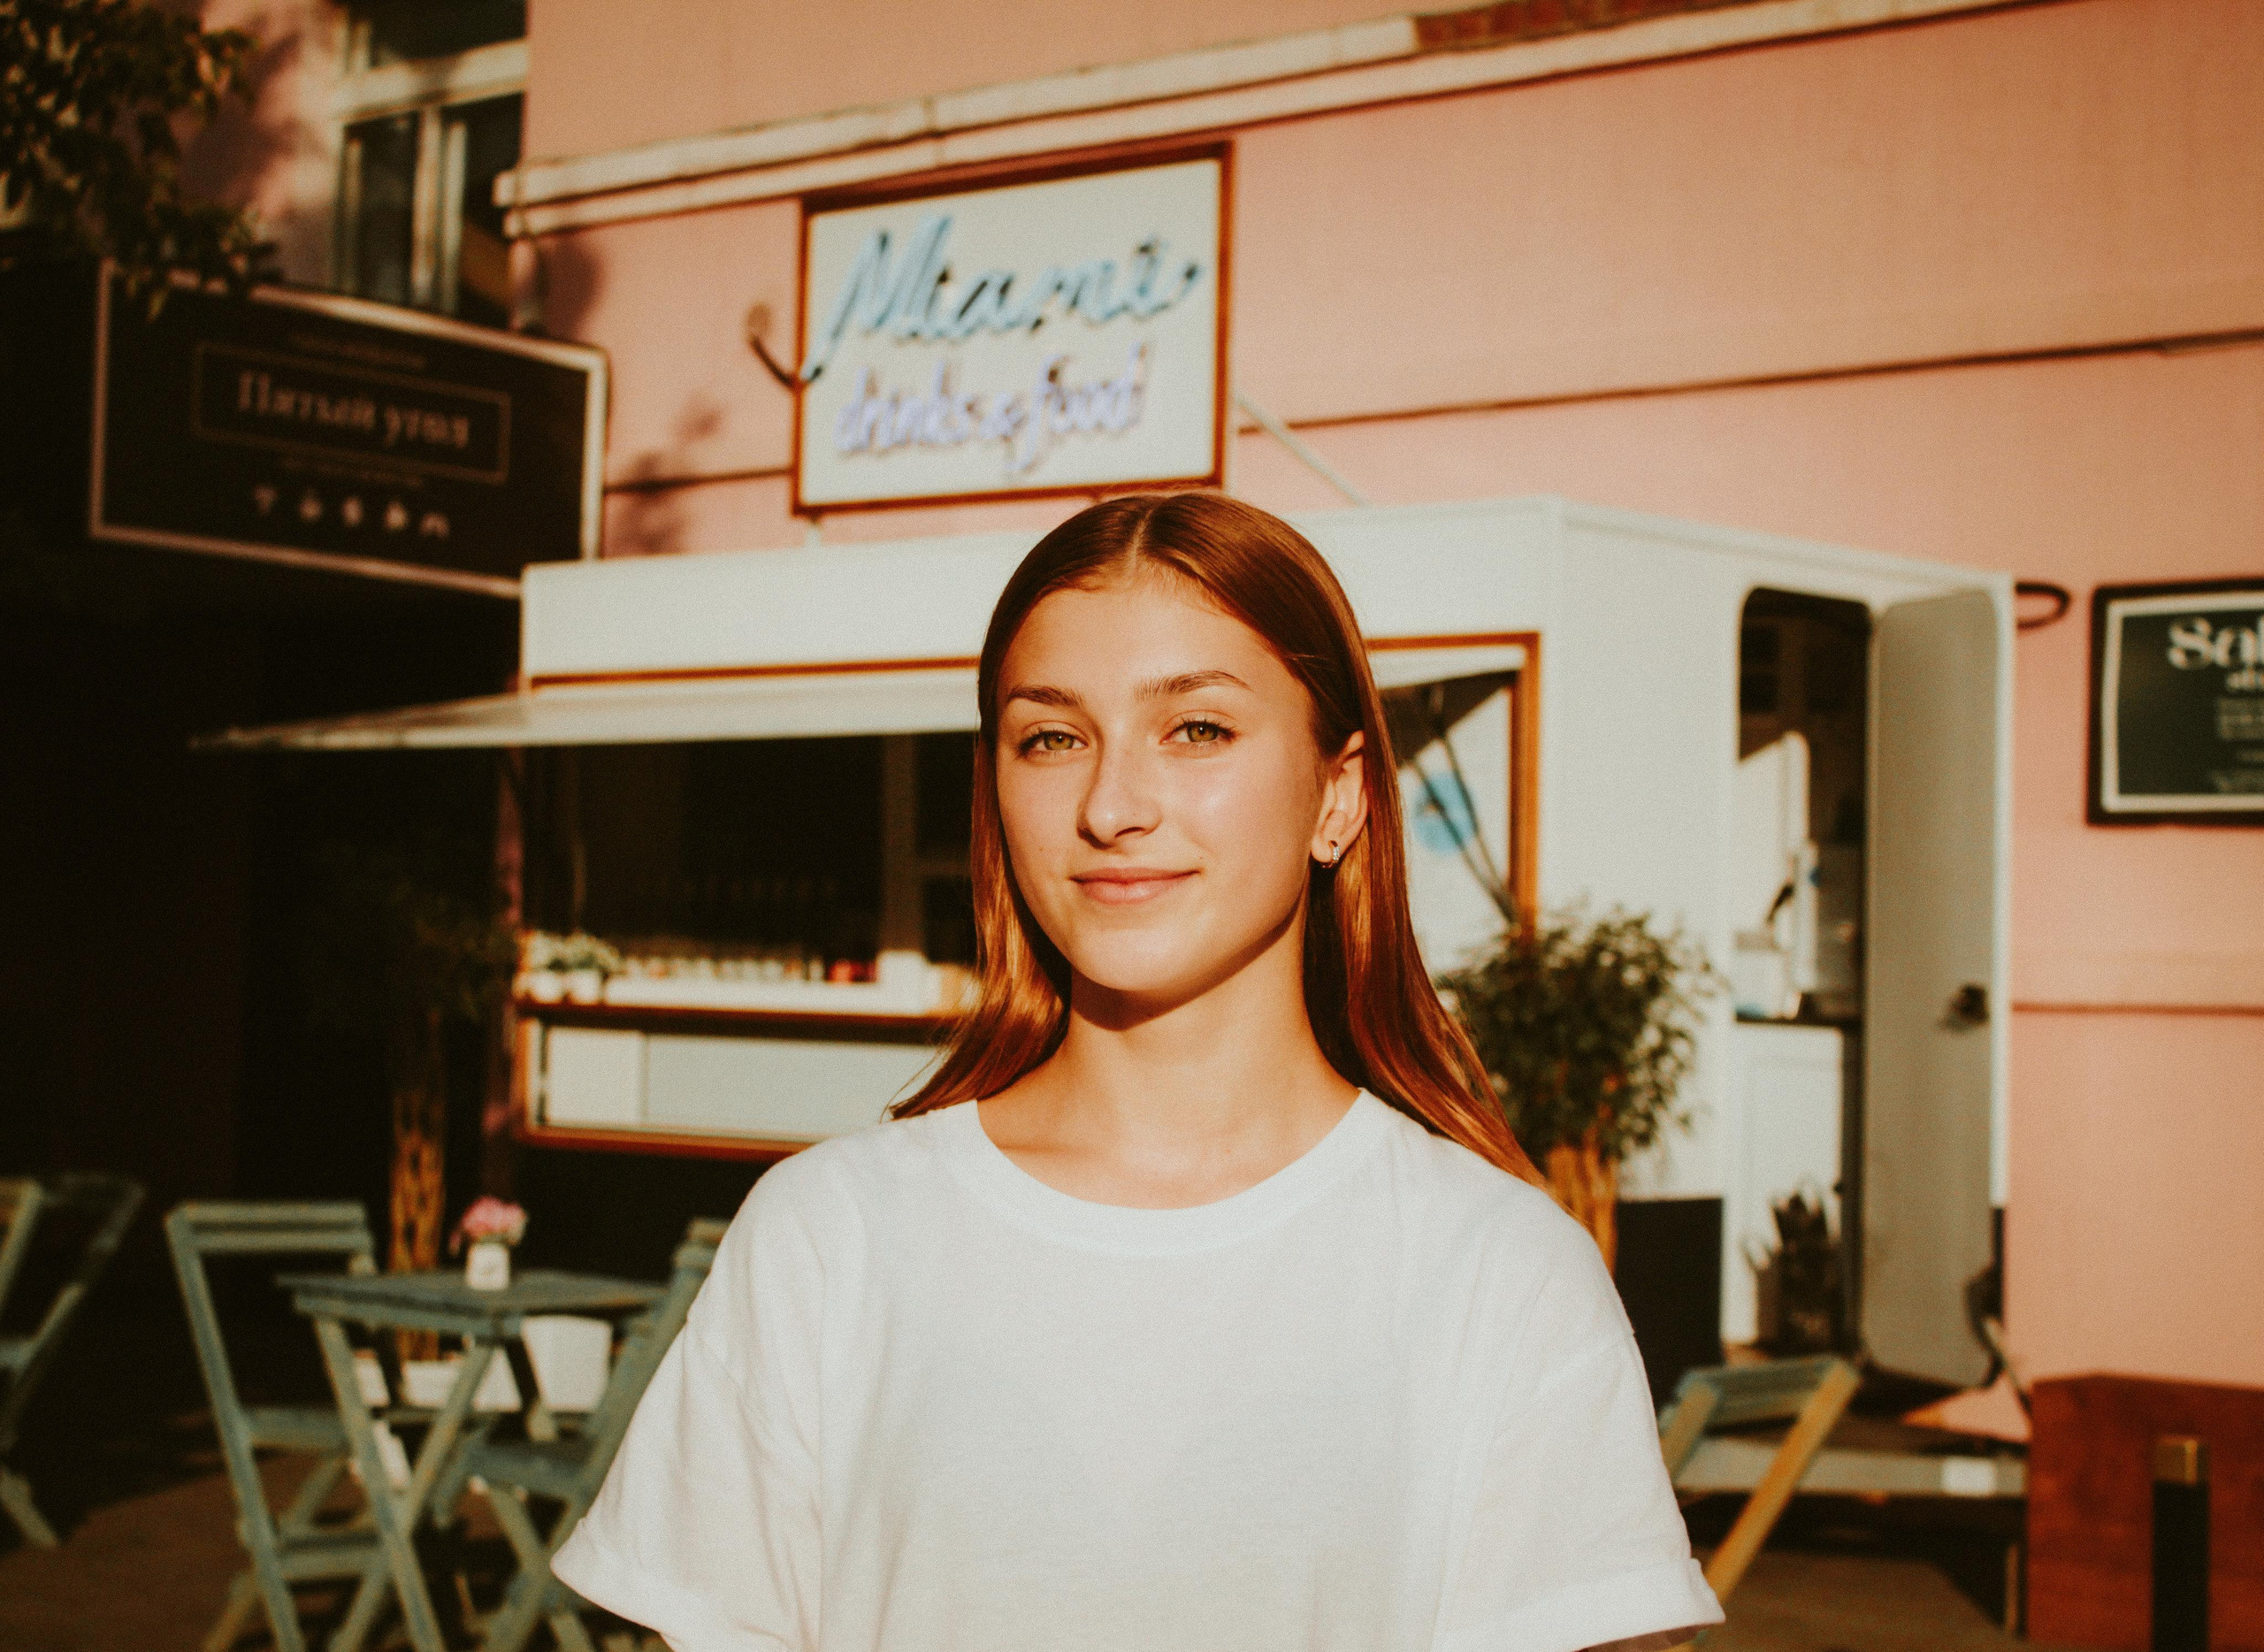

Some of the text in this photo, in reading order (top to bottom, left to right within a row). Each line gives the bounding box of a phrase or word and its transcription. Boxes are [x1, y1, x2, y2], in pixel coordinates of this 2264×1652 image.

[800, 215, 1204, 381] Miami
[834, 359, 972, 453] drinks
[1006, 340, 1143, 470] food
